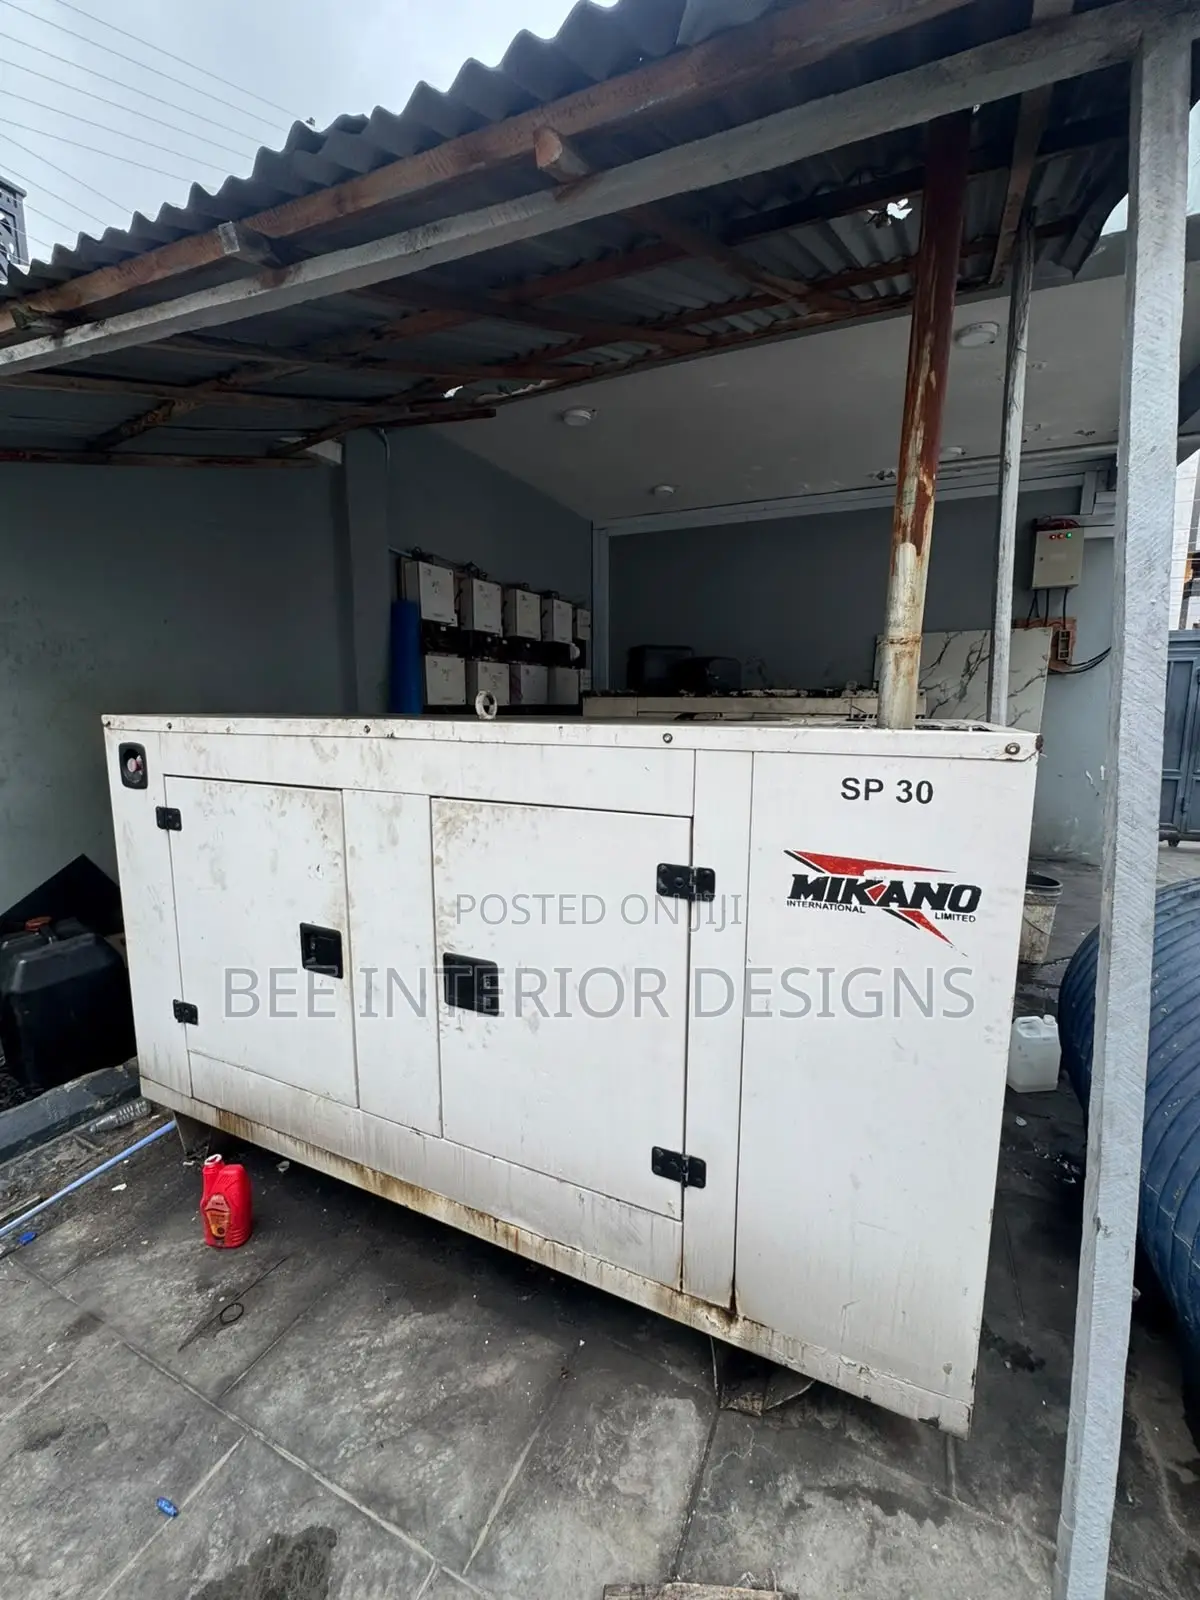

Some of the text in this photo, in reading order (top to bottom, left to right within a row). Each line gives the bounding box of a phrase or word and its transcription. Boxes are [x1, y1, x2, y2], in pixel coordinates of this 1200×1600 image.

[841, 777, 934, 804] SP 30
[787, 873, 982, 913] MIKANO
[786, 900, 976, 923] INTERNATIONAL LIMITED
